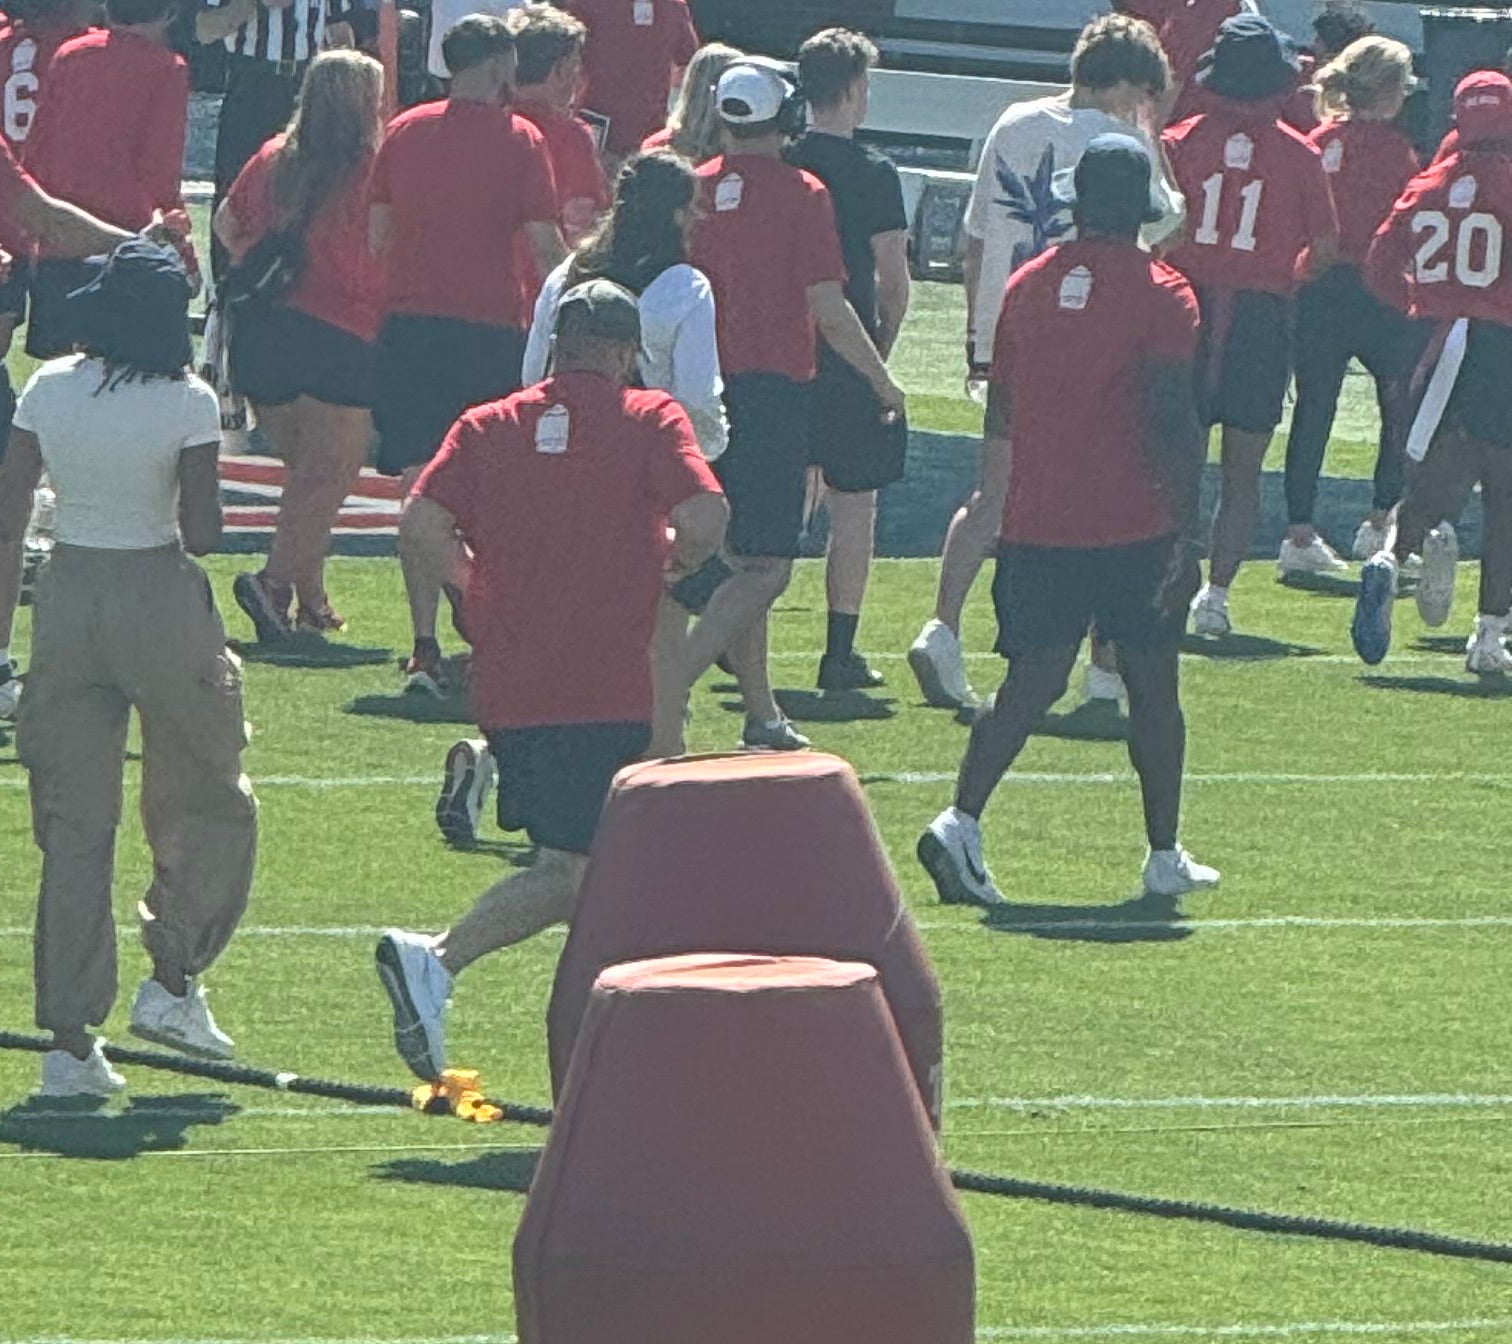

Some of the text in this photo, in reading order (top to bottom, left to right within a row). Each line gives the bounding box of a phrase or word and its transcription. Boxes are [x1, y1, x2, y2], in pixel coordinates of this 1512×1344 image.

[4, 71, 39, 141] 6
[1194, 172, 1264, 251] 11
[1411, 210, 1502, 287] 20
